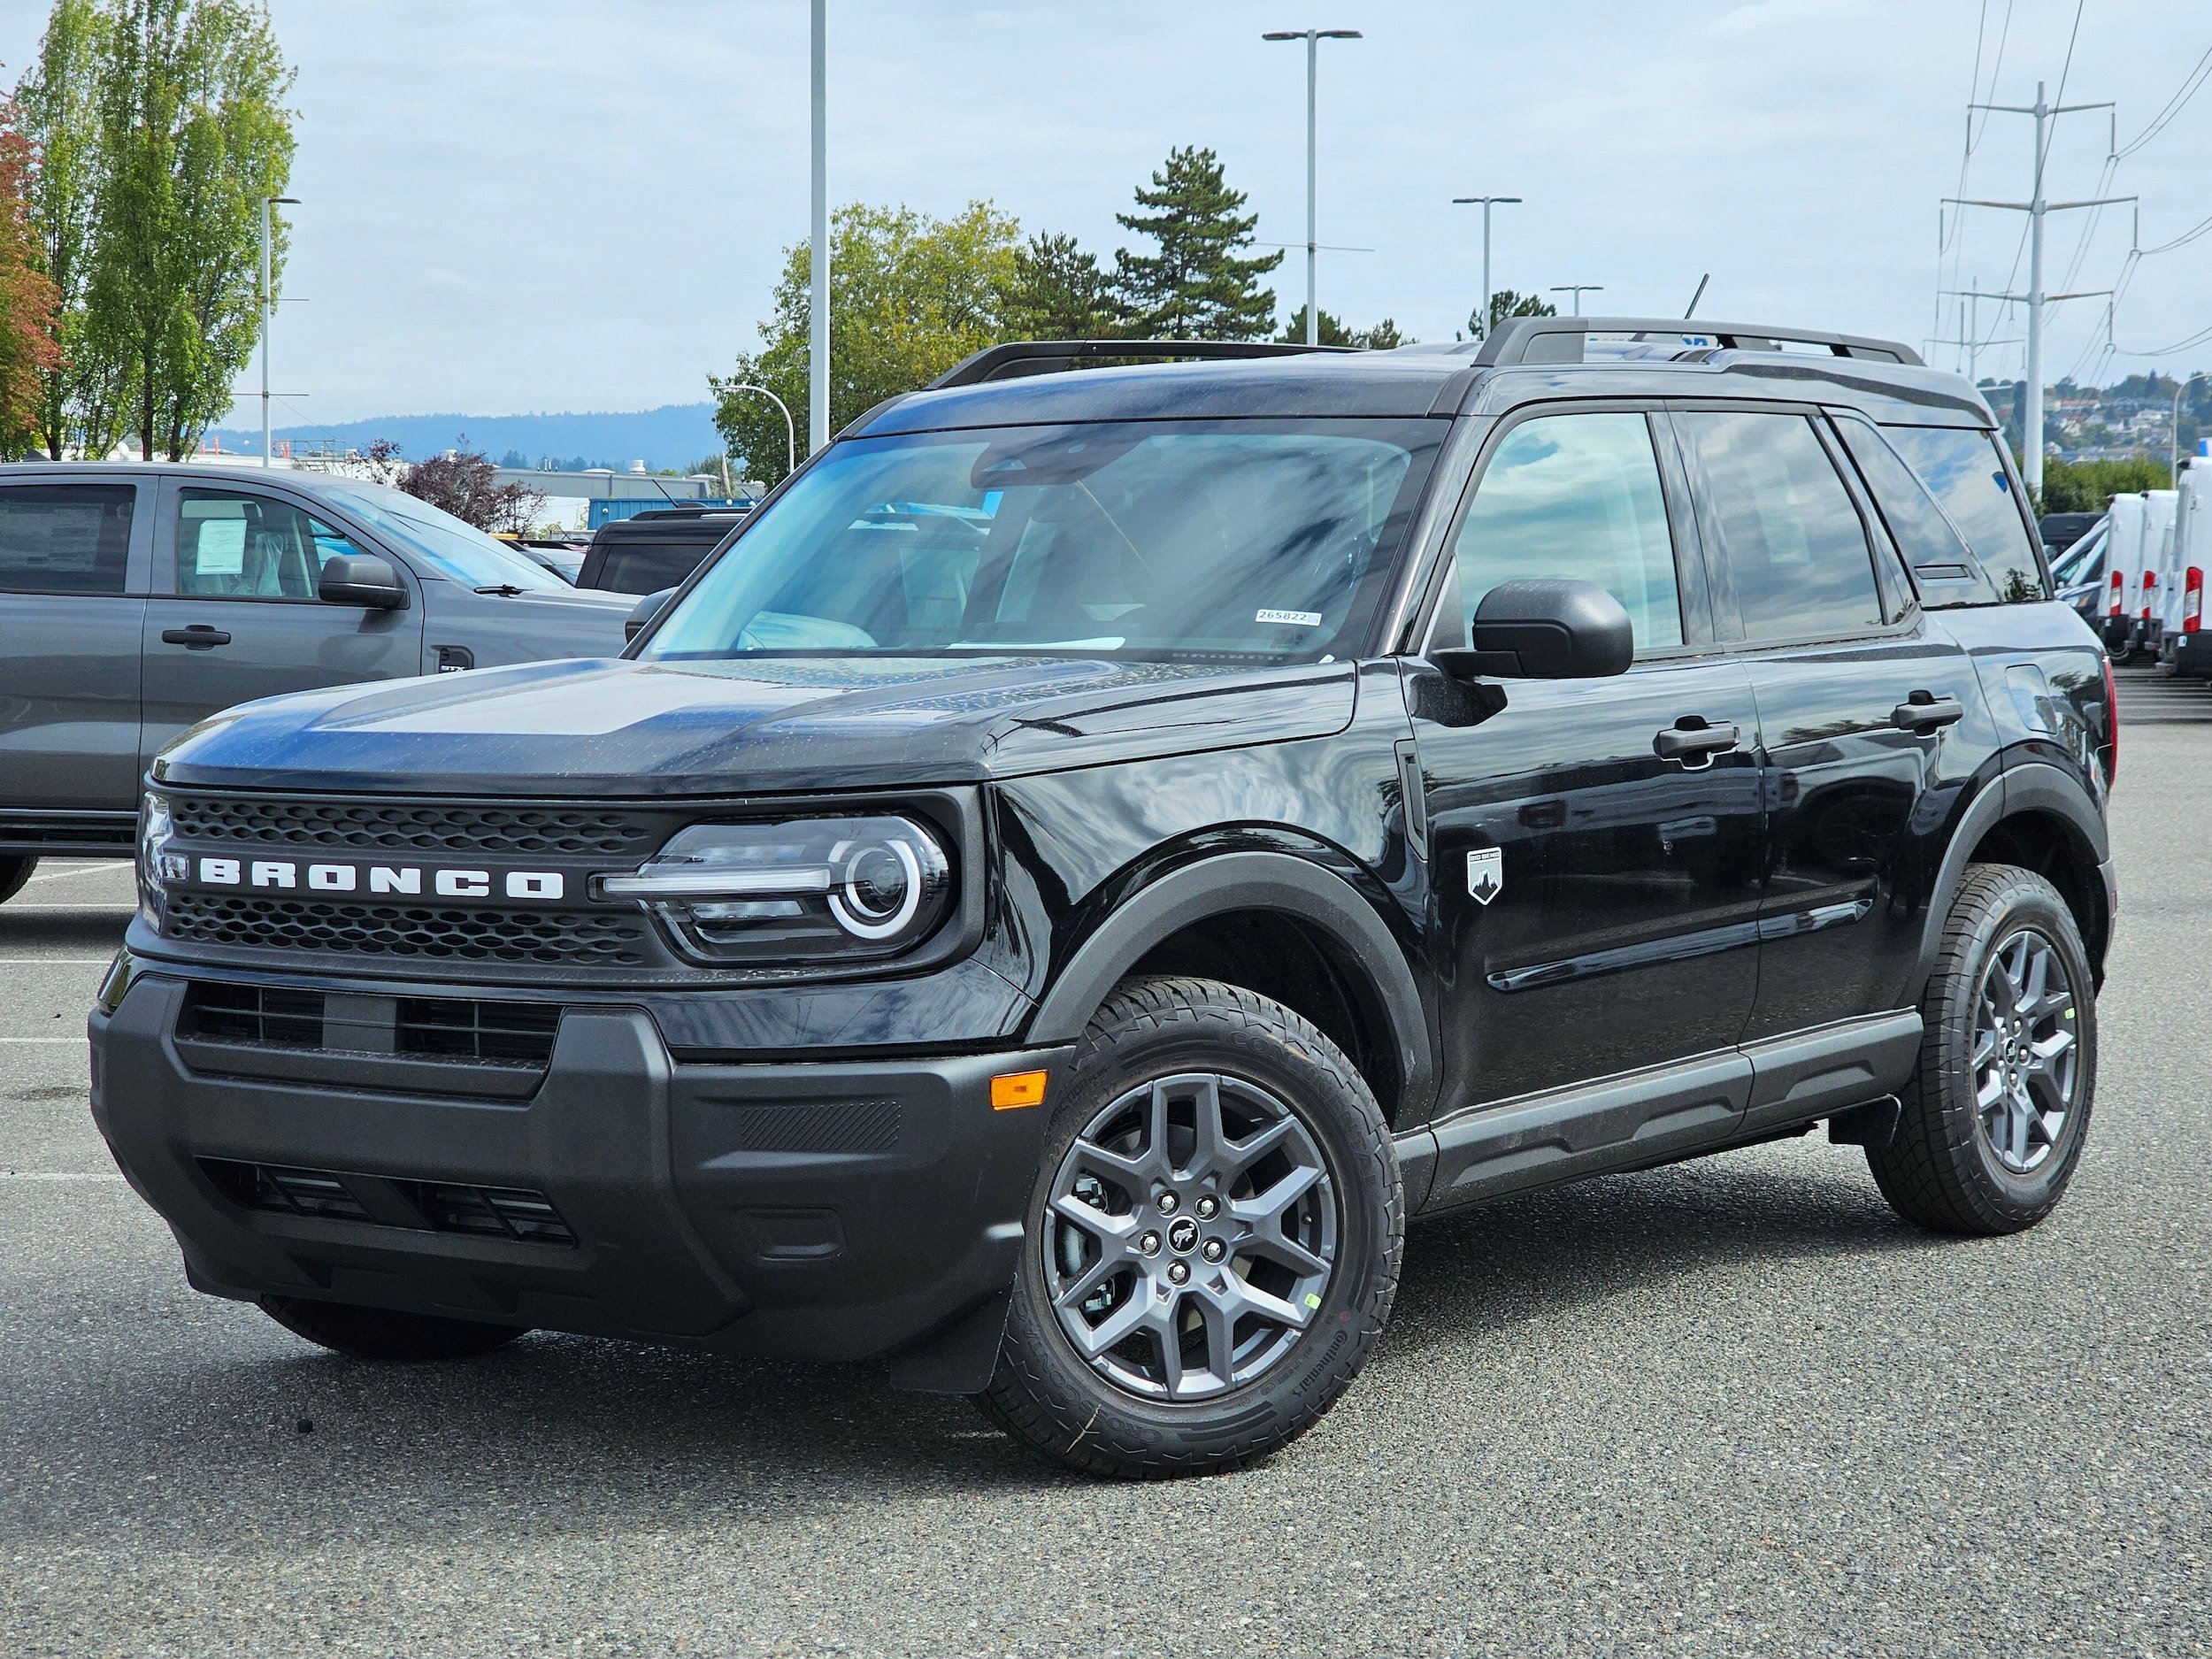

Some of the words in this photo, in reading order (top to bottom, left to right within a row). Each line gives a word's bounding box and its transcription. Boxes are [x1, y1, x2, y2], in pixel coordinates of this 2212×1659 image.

[1259, 611, 1307, 621] 265822
[200, 857, 564, 900] BRONCO
[1226, 1032, 1377, 1186] CONTINENTAL
[1301, 1329, 1348, 1392] Continental
